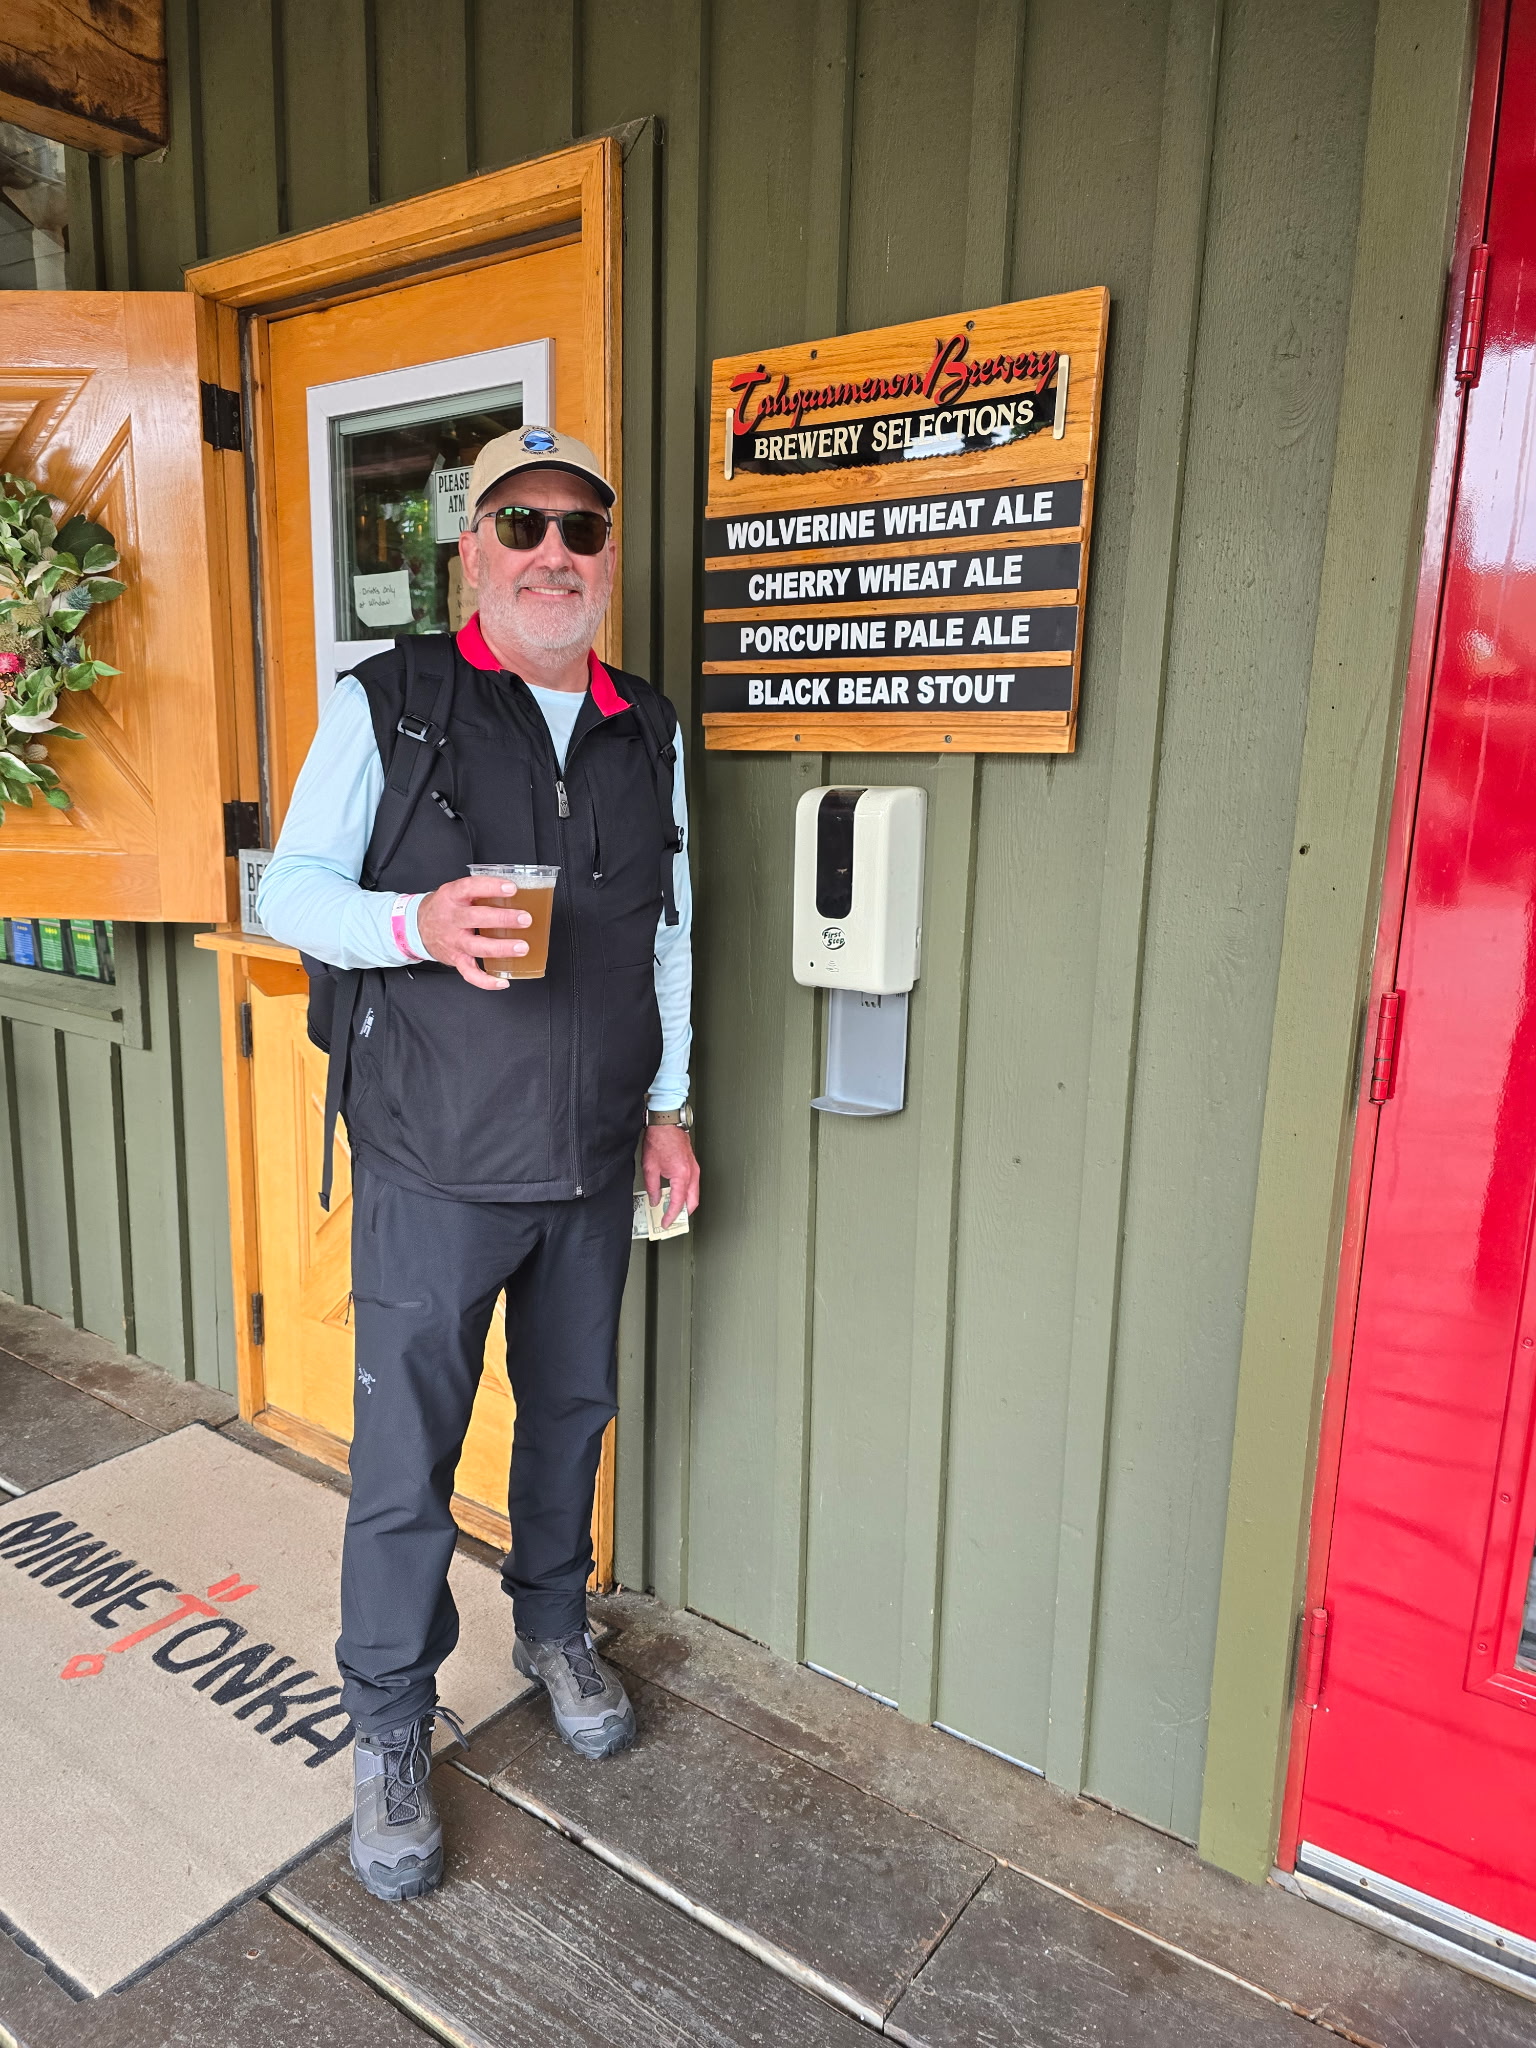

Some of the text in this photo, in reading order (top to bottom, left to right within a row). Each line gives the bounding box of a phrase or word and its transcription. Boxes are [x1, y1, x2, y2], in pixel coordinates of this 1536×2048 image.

[729, 333, 1058, 436] Tahquamenon Brewery
[754, 400, 1034, 461] BREWERY SELECTIONS
[438, 472, 470, 494] PLEASE
[448, 494, 466, 513] ATM
[726, 490, 1054, 550] WOLVERINE WHEAT ALE
[748, 554, 1023, 602] CHERRY WHEAT ALE
[740, 614, 1031, 654] PORCUPINE PALE ALE
[748, 674, 1016, 706] BLACK BEAR STOUT
[824, 931, 841, 939] First
[827, 937, 845, 946] Step
[0, 1510, 356, 1769] MINNETONKA
